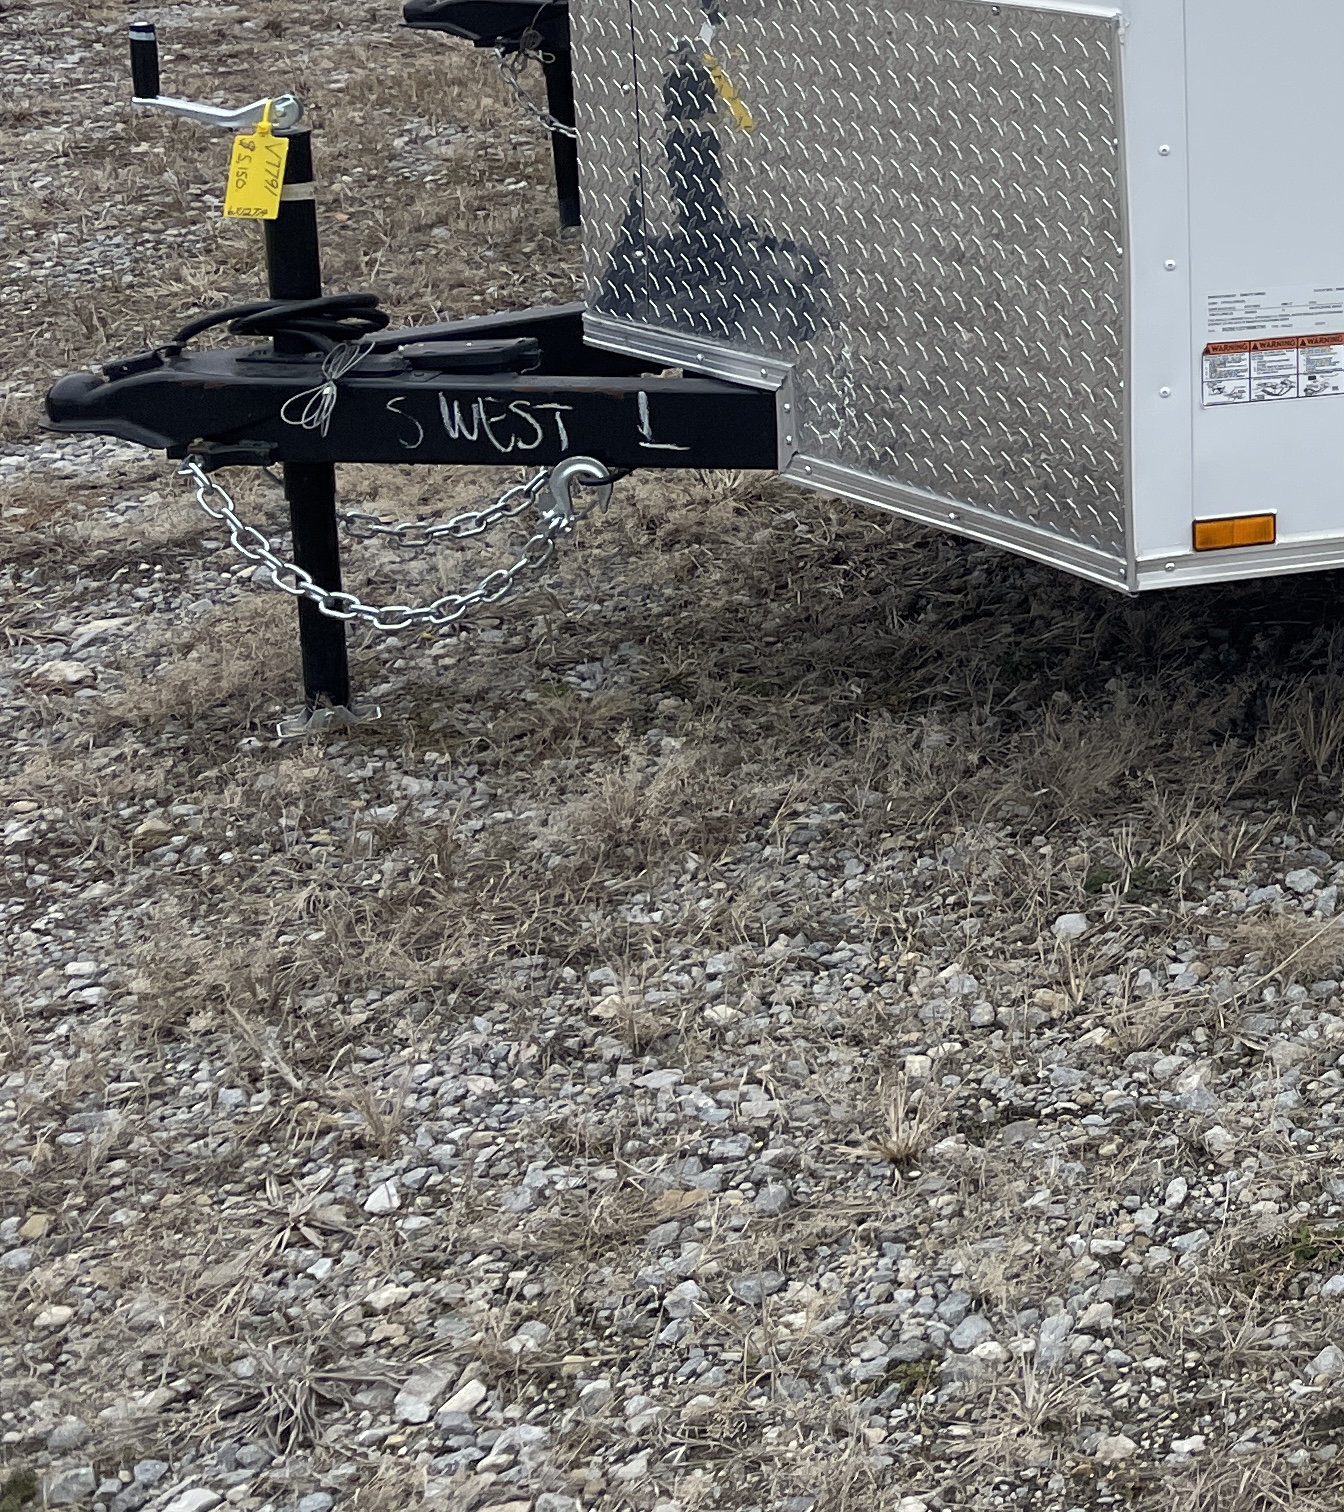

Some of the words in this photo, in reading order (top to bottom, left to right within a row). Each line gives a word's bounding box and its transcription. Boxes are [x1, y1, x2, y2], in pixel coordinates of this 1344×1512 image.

[1259, 339, 1296, 349] WARNING
[1307, 334, 1343, 345] WARNING
[1211, 343, 1248, 353] WARNING
[438, 391, 574, 453] WEST
